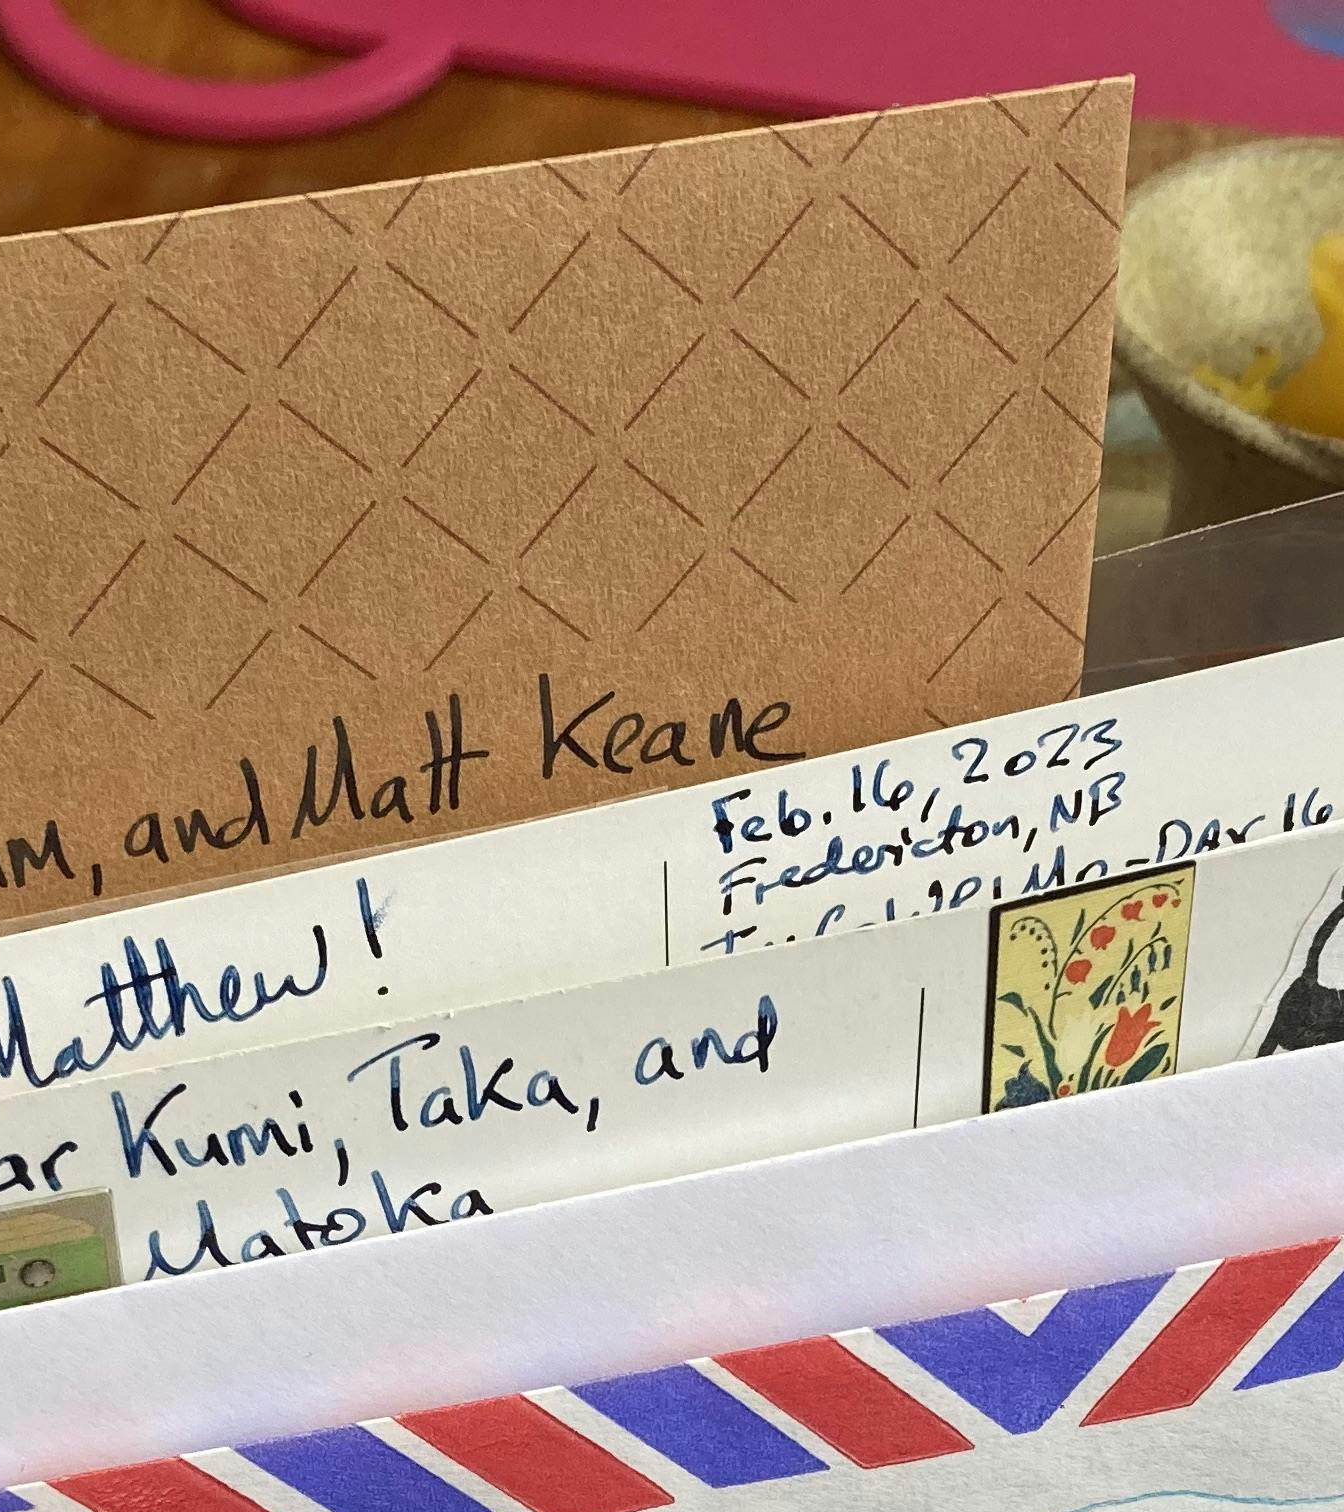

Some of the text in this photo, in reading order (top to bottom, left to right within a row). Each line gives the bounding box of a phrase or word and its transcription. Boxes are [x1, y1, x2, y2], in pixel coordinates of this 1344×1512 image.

[123, 756, 269, 864] and
[290, 693, 490, 840] Matt
[537, 672, 806, 780] Keane
[711, 717, 1124, 855] Feb. 16, 2023
[719, 805, 1037, 916] Fredericton,
[1050, 771, 1126, 834] NB
[110, 1083, 350, 1187] Kumi,
[346, 1032, 600, 1133] Taka,
[633, 994, 780, 1086] and
